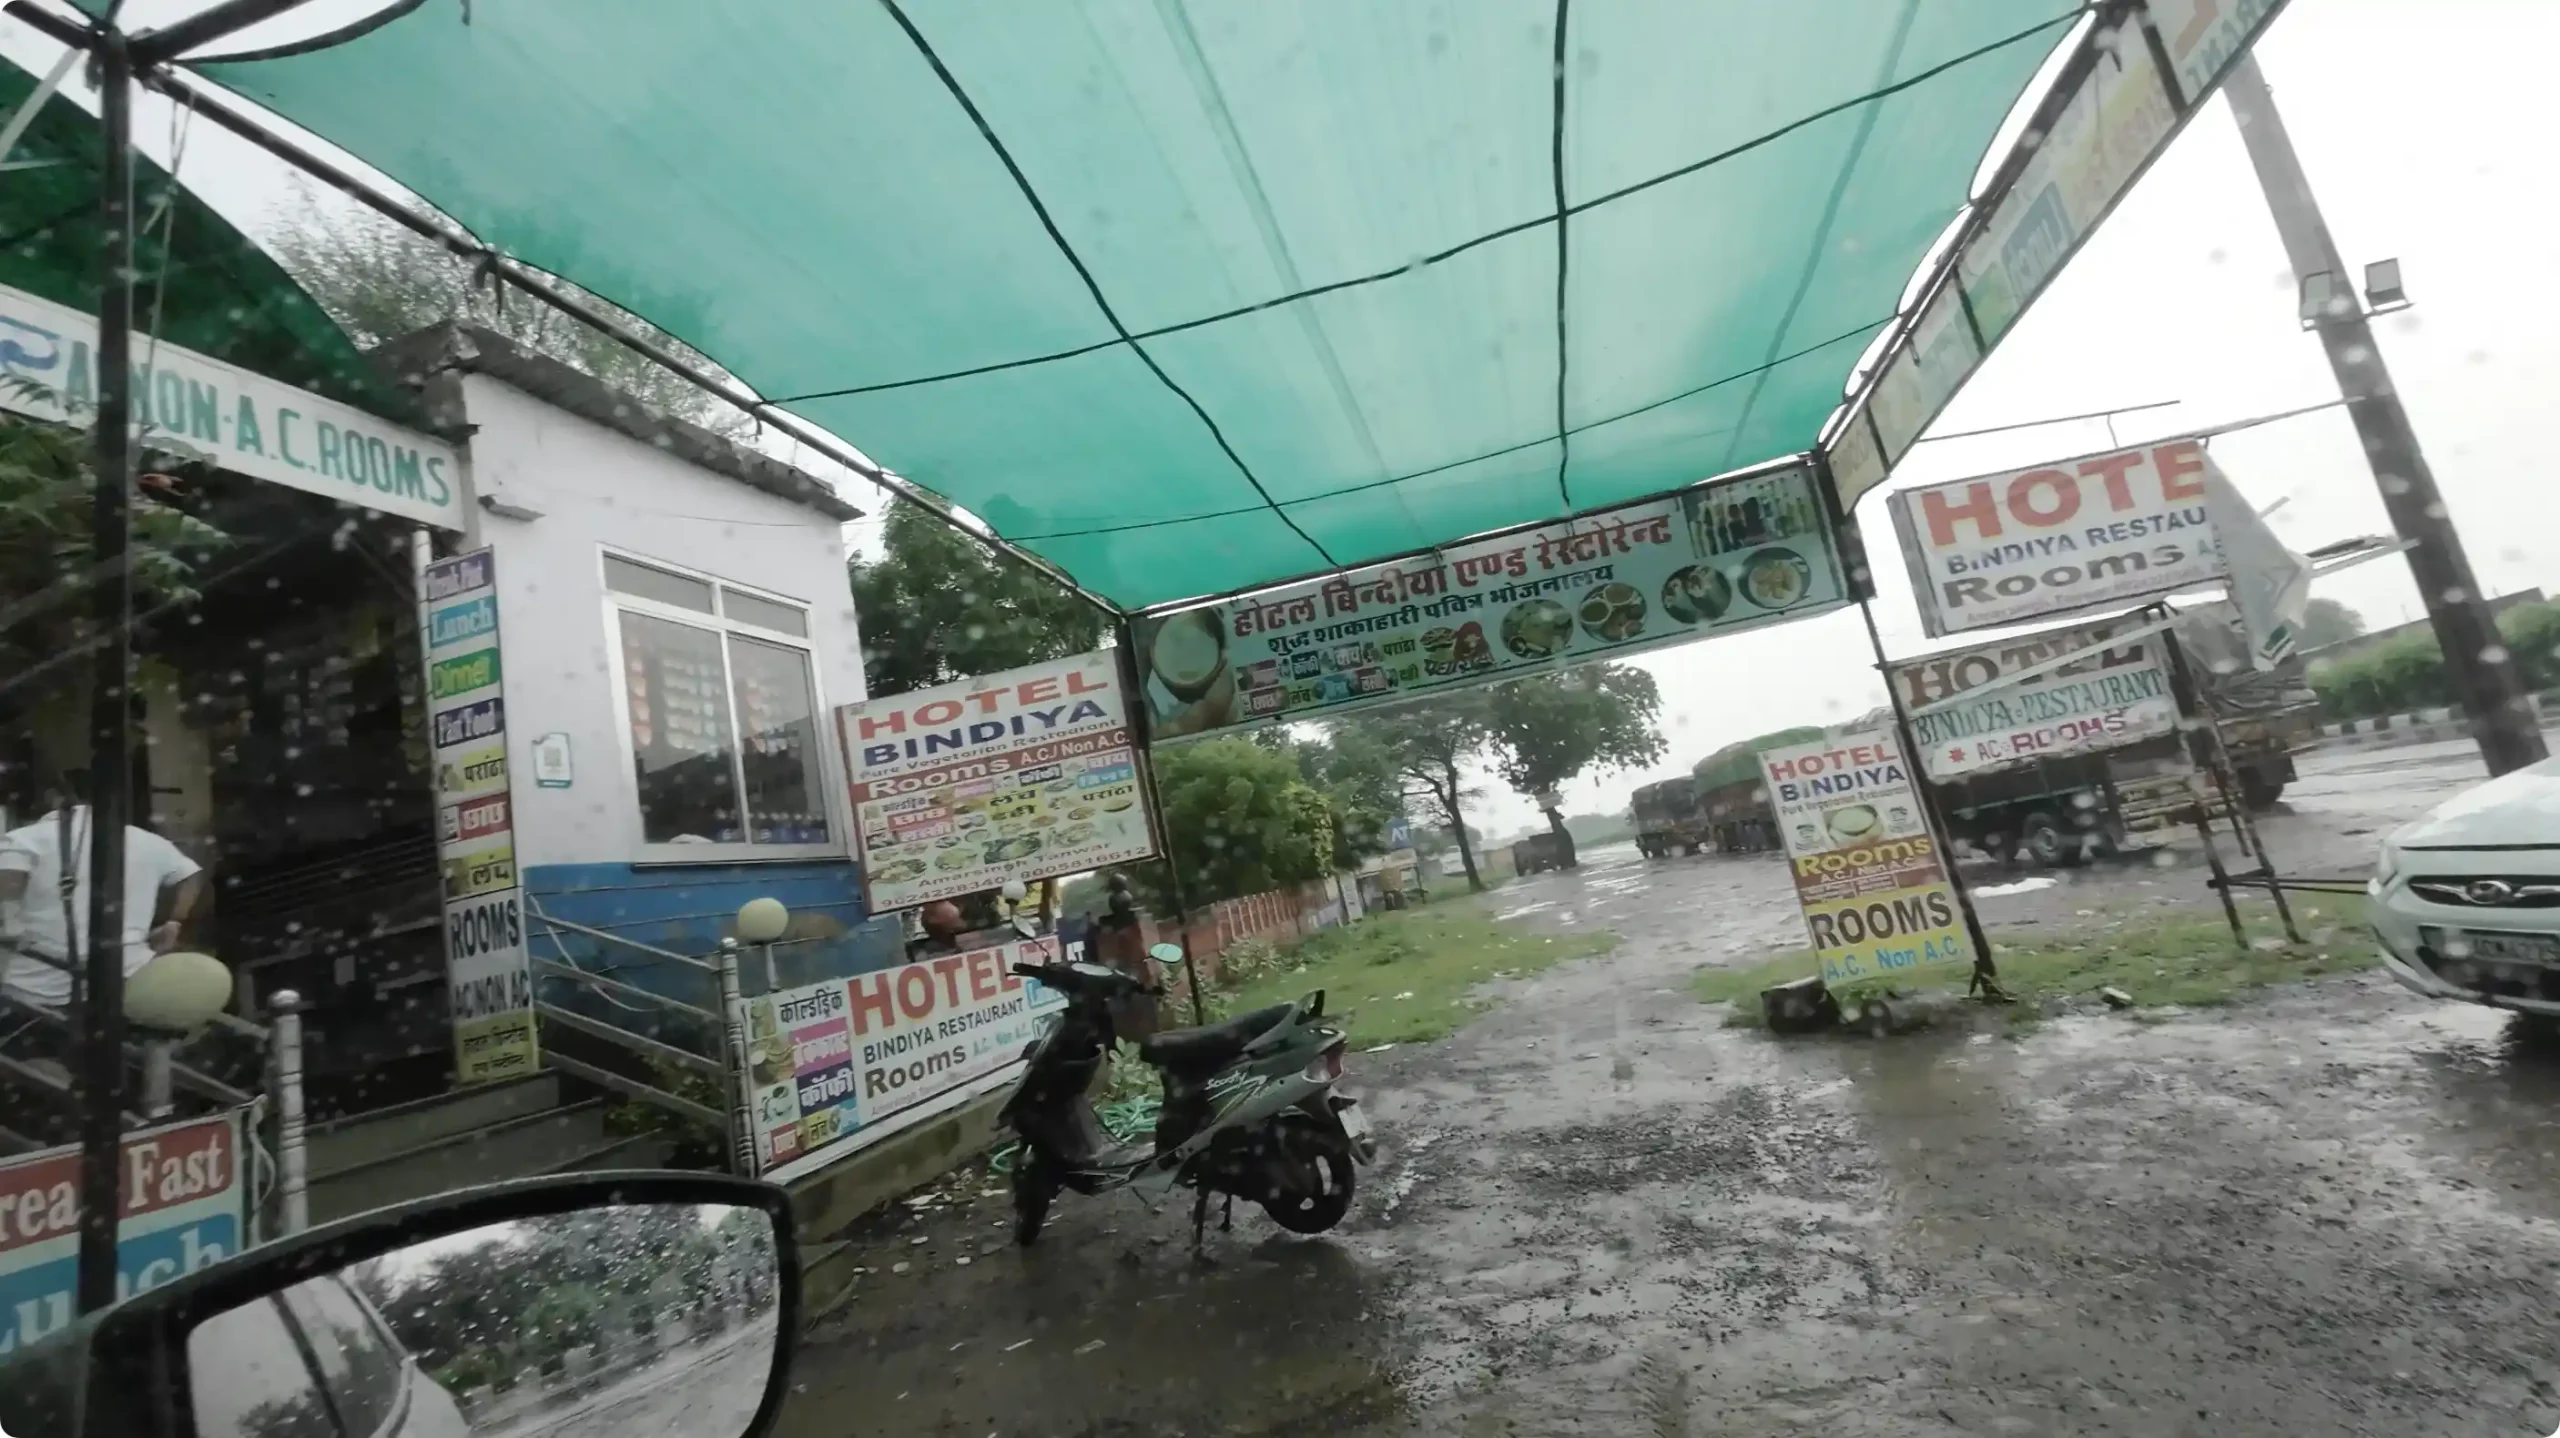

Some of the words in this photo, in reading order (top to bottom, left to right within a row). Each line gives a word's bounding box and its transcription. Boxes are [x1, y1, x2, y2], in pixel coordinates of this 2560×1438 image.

[1919, 440, 2206, 548] HOTE
[1947, 532, 2079, 576] BINDIYA
[2086, 505, 2206, 547] RESTAU
[1234, 594, 1317, 639] होटल
[1453, 547, 1528, 587] एण्ड
[1942, 543, 2186, 609] Rooms
[431, 598, 495, 642] Lunch
[1268, 631, 1310, 657] शुद्ध
[1313, 604, 1420, 645] शाकाहारी
[1425, 592, 1485, 619] पवित्र
[1489, 563, 1614, 604] भोजनालय
[857, 671, 1108, 741] HOTEL
[863, 699, 1107, 767] BINDIYA
[2009, 711, 2128, 753] ROOMS
[868, 756, 1011, 799] Rooms
[1061, 739, 1094, 757] Non
[1097, 730, 1131, 748] A.C.
[1767, 743, 1897, 783] HOTEL
[1778, 764, 1906, 802] BINDIYA
[1795, 835, 1932, 877] Rooms
[450, 898, 520, 959] ROOMS
[1809, 890, 1953, 950] ROOMS
[1875, 946, 1917, 970] Non
[847, 948, 1023, 1036] HOTEL
[863, 1026, 935, 1065] BINDIYA
[938, 997, 1025, 1039] RESTAURANT
[865, 1044, 968, 1100] Rooms
[0, 1180, 82, 1242] rea
[127, 1134, 226, 1209] Fast
